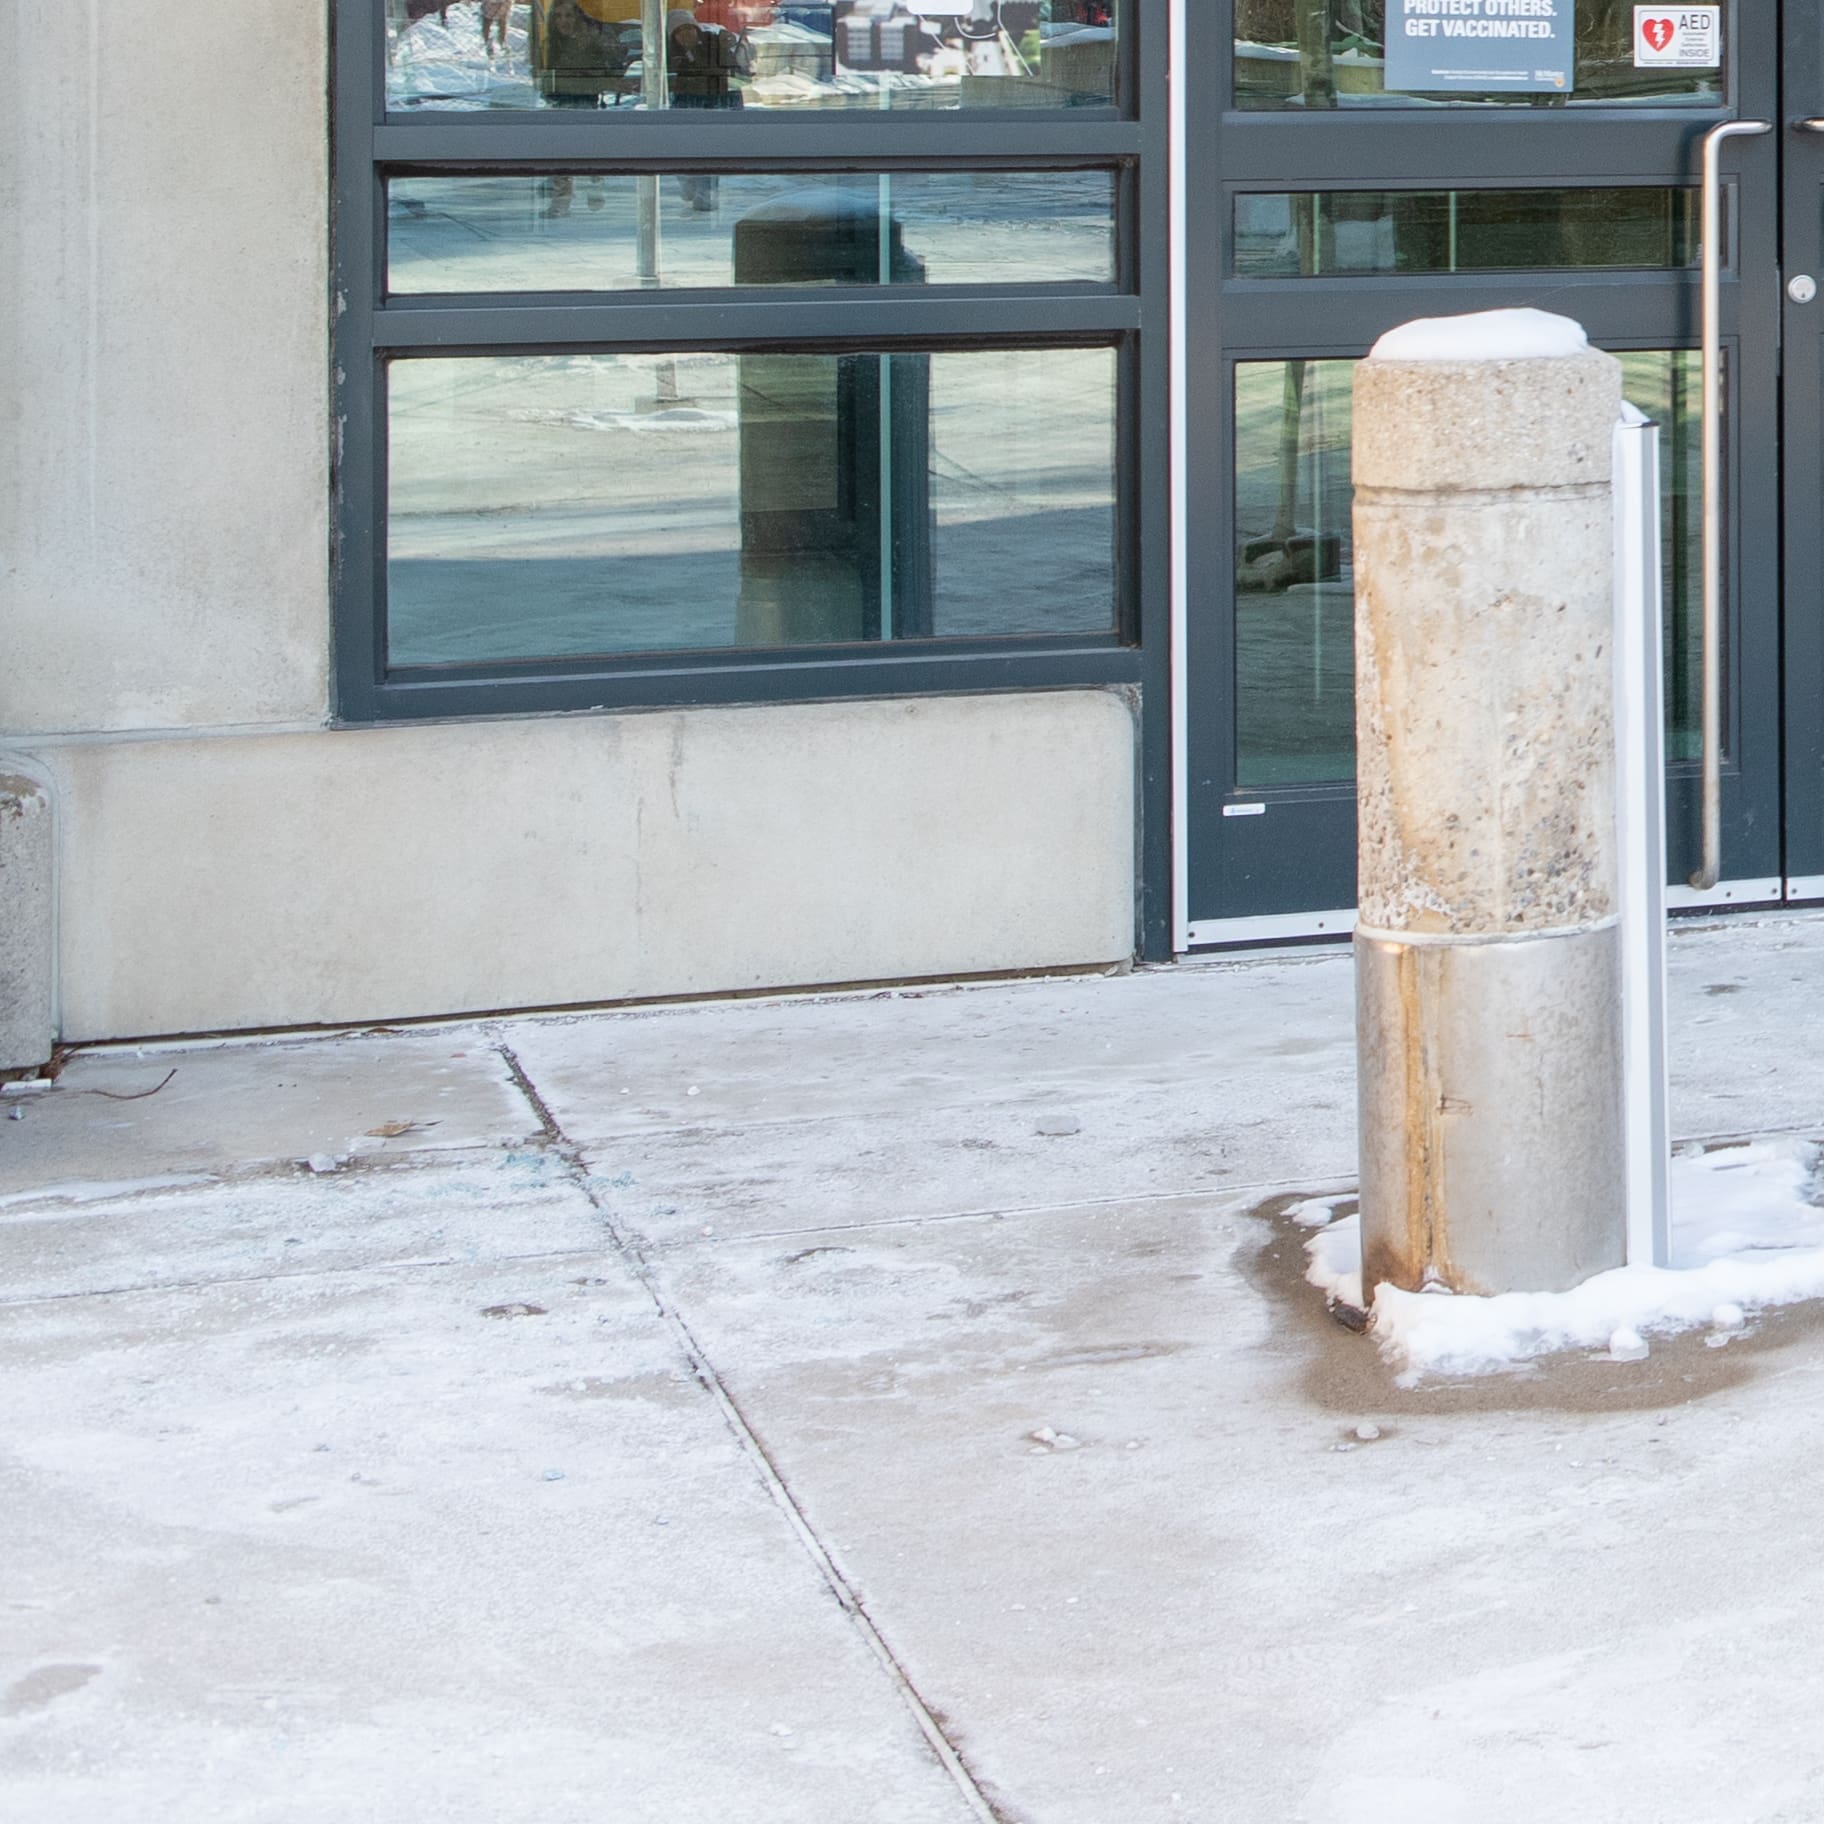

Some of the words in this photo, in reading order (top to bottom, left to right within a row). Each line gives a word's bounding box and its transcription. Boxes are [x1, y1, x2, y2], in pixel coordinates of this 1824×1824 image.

[1405, 18, 1440, 37] GET
[1441, 19, 1556, 38] VACCINATED.
[1679, 14, 1711, 30] AED
[1679, 49, 1711, 58] INSIDE
